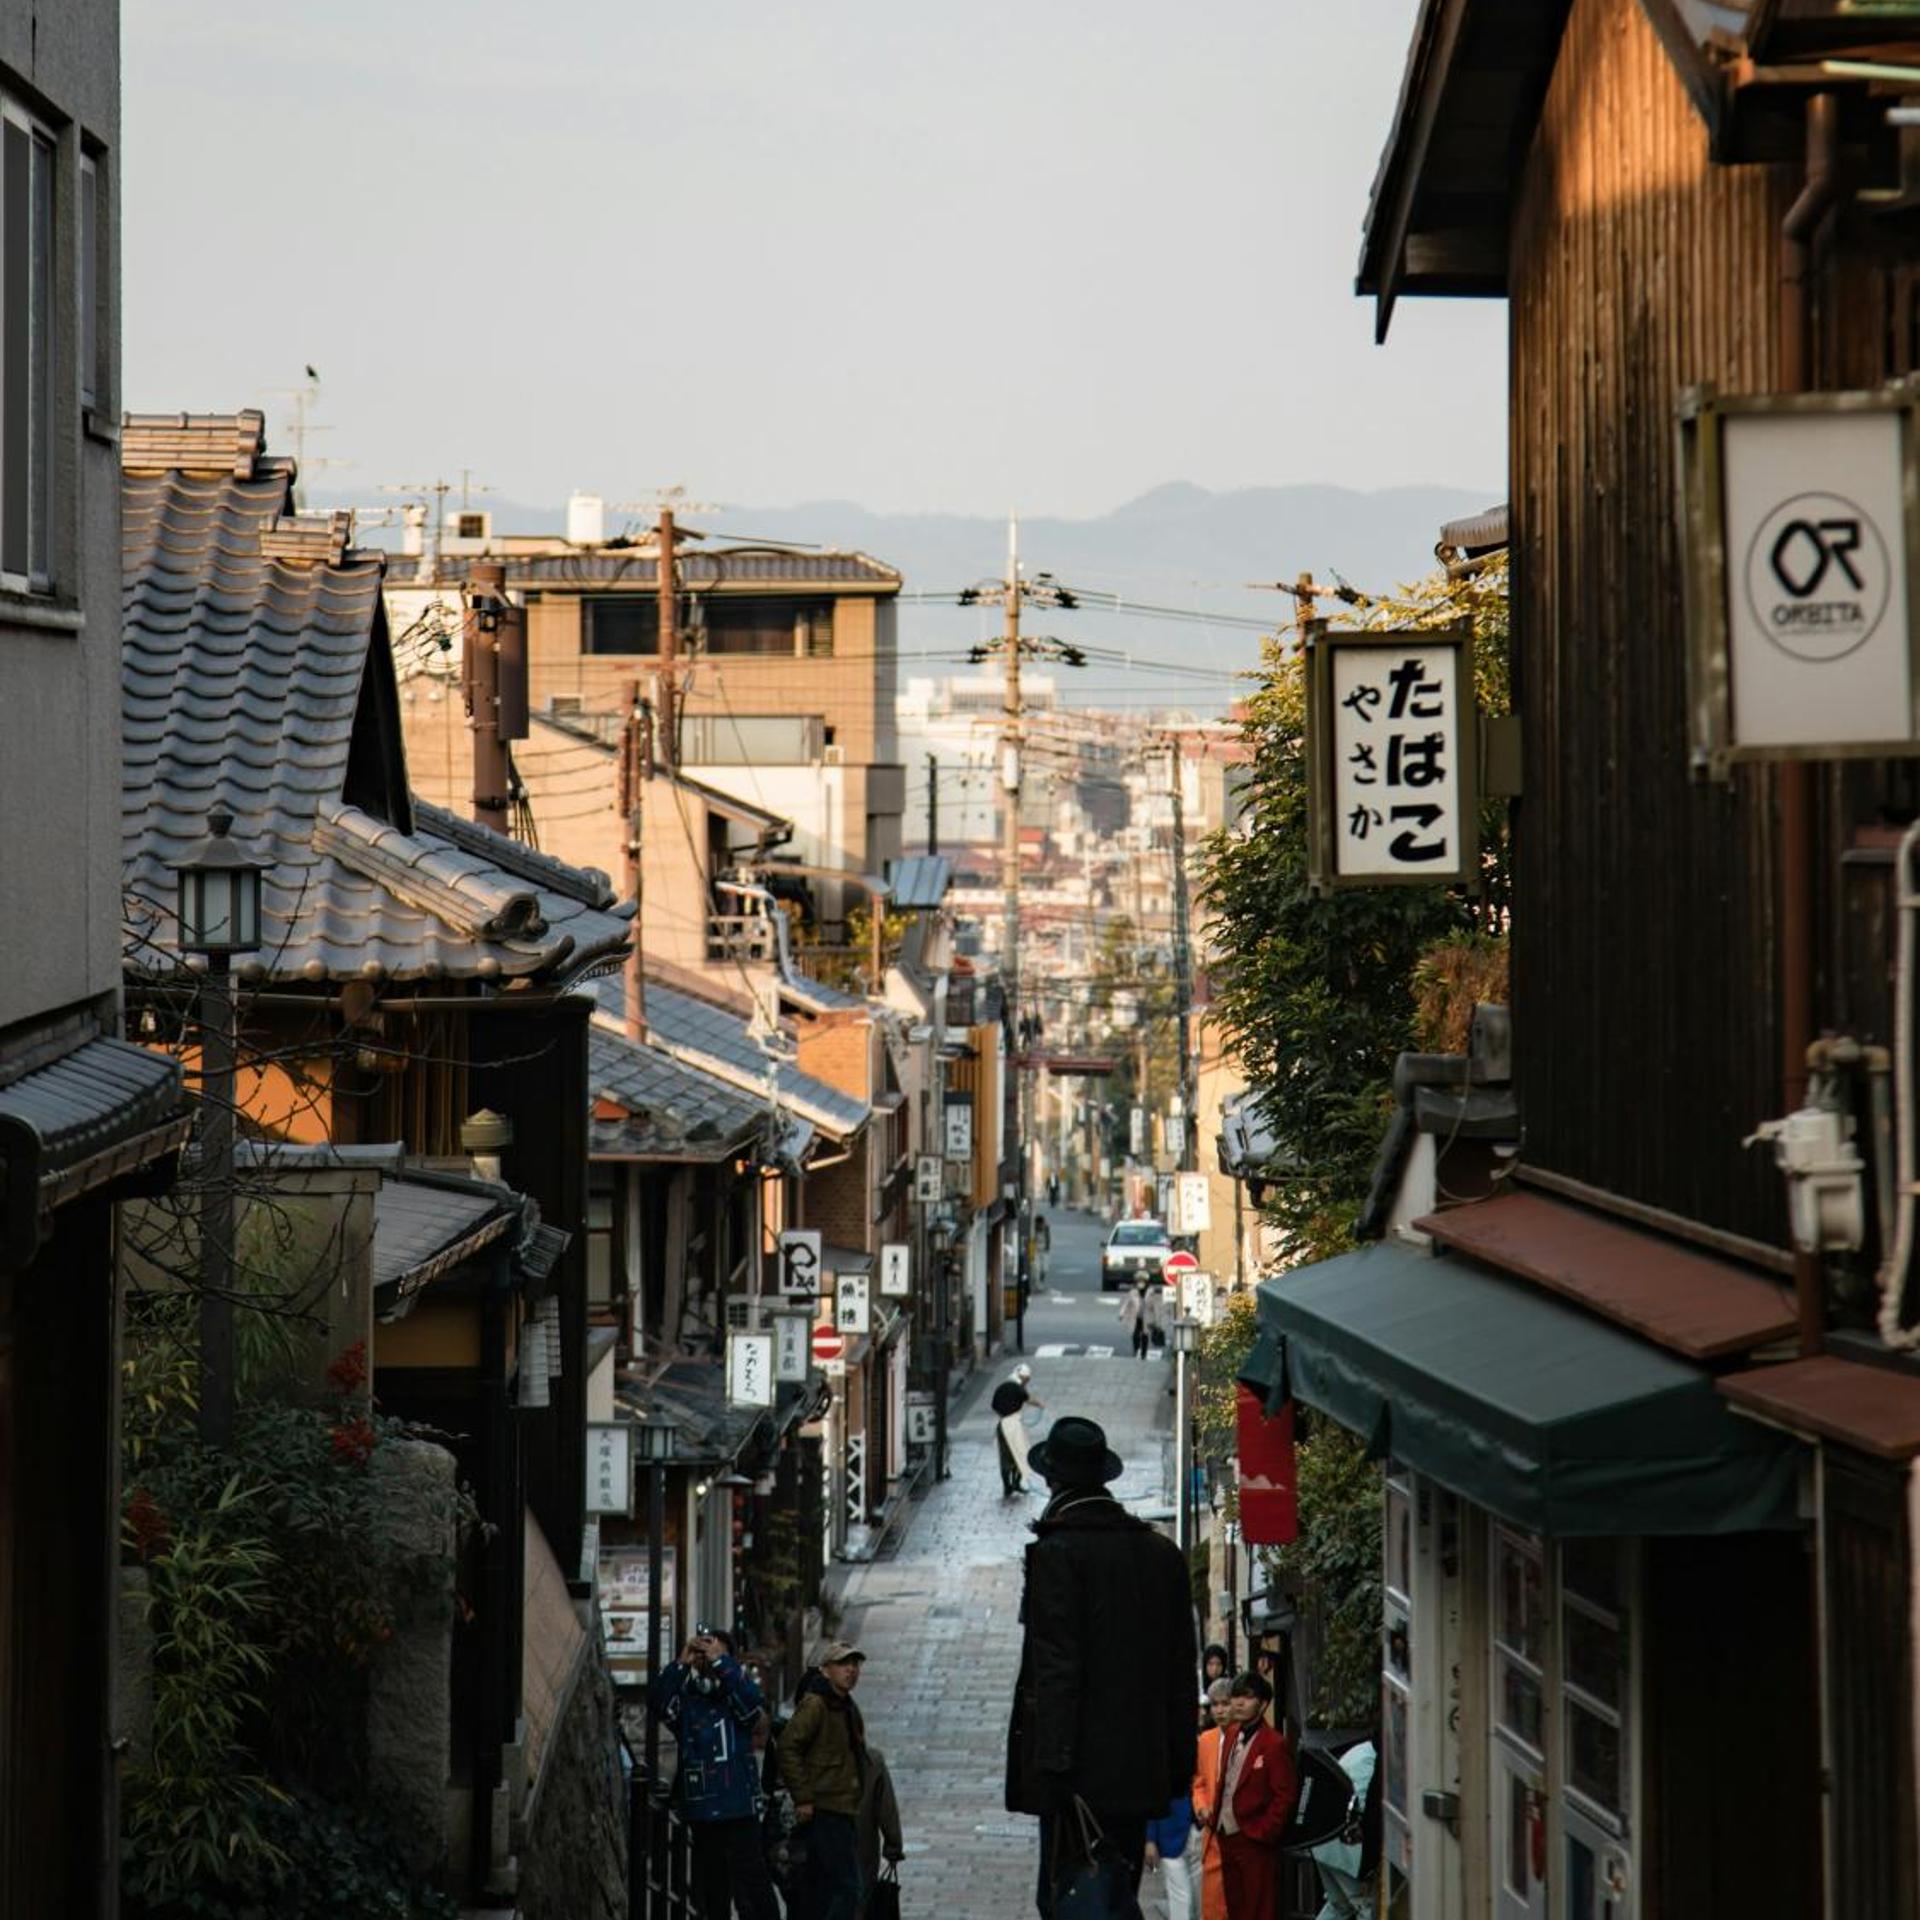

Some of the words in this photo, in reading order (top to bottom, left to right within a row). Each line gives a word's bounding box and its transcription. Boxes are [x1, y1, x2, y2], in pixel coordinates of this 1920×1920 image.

[1771, 601, 1865, 626] ORBITA
[1341, 684, 1384, 840] やさか
[1387, 659, 1447, 862] たばこ
